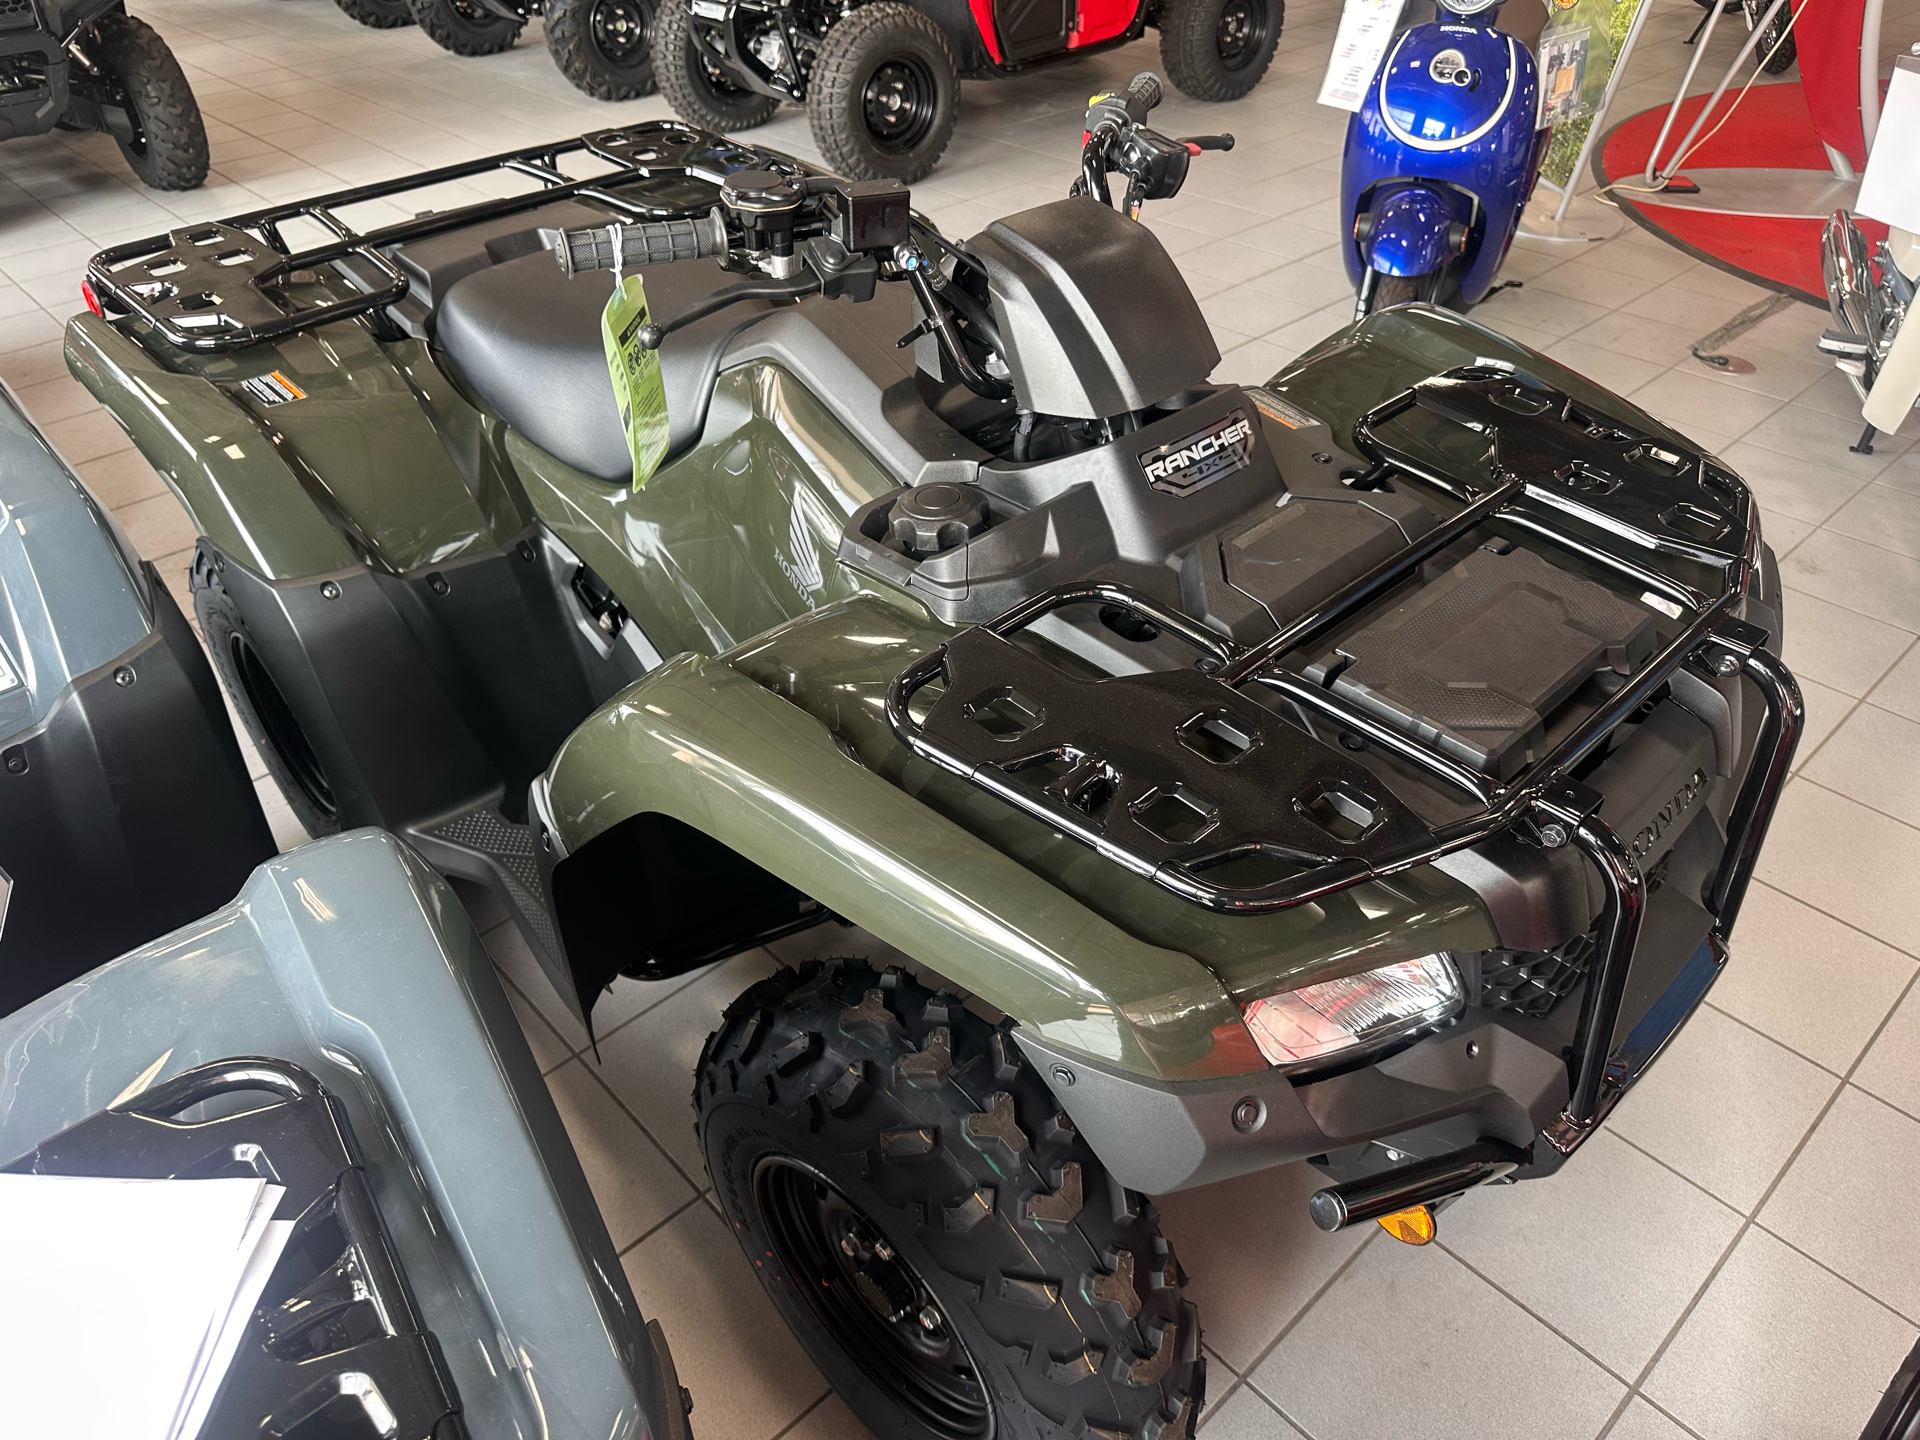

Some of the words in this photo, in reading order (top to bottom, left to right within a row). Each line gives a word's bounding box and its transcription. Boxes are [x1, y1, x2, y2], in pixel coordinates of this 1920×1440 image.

[1440, 25, 1478, 35] HONDA
[1144, 418, 1252, 483] RANCHER
[773, 547, 816, 611] HONDA
[1631, 766, 1709, 859] ONDA
